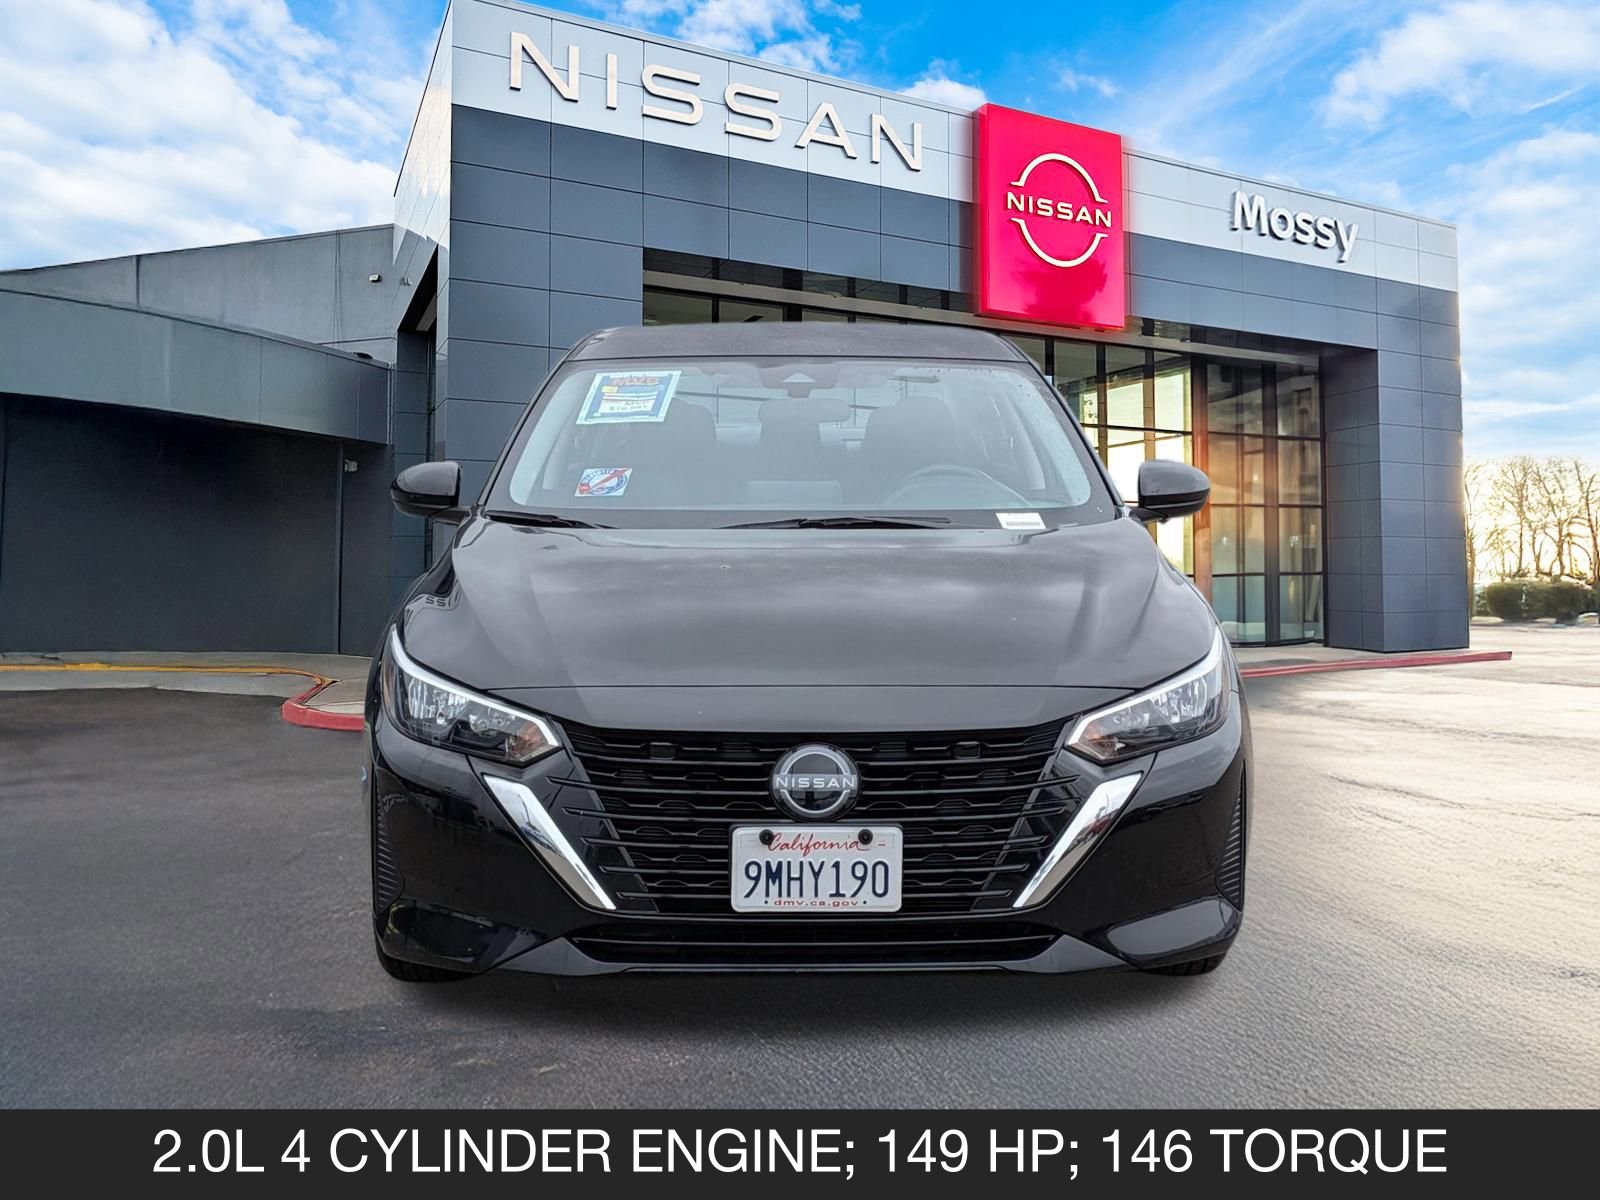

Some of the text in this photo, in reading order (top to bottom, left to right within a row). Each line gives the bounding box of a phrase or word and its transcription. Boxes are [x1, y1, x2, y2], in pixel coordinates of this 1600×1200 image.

[510, 31, 922, 172] NISSAN
[1007, 192, 1112, 228] NISSAN
[1231, 190, 1359, 262] Mossy
[775, 777, 856, 788] NISSAN
[767, 832, 866, 857] California
[743, 860, 890, 899] 9MHY190
[773, 899, 860, 908] dmv.ca.gov
